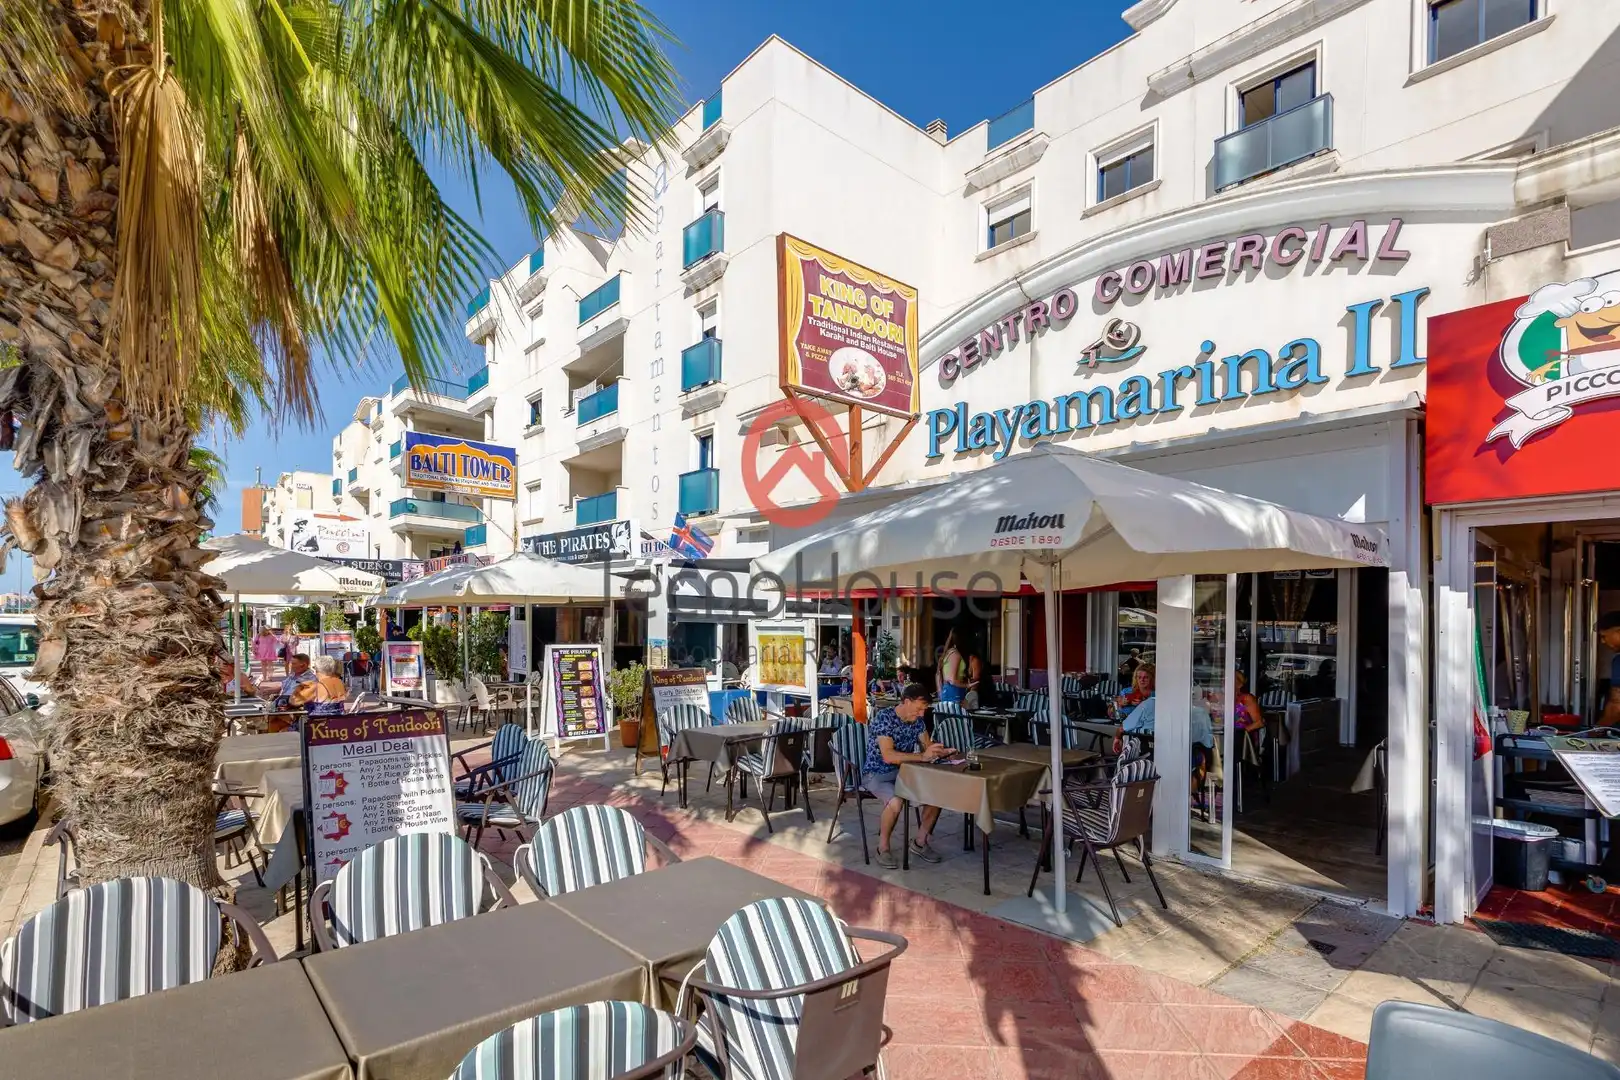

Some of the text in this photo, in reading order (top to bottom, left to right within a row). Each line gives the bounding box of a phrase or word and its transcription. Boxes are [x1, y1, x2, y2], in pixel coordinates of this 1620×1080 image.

[819, 273, 894, 319] KING OF
[938, 217, 1412, 382] CENTRO COMERCIAL
[808, 293, 905, 346] TANDOORI
[807, 316, 906, 354] Traditional Indian Restaurant
[819, 328, 898, 359] Karahi and Balti House
[925, 286, 1431, 461] Playamarina II
[411, 451, 511, 483] BALTI TOWER
[411, 471, 440, 481] TRADITIONAL
[994, 511, 1066, 533] Mahou
[317, 525, 365, 537] Puccini
[535, 531, 611, 556] THE PIRATES
[990, 535, 1061, 547] DESDE 1890
[338, 577, 373, 587] Mahou
[652, 673, 704, 685] King of Tandoori
[310, 715, 442, 741] King of Tandoori
[342, 739, 414, 756] Meal Deal
[417, 751, 443, 760] Pickles
[360, 766, 374, 775] Any
[384, 763, 402, 771] Main
[404, 761, 430, 769] Course
[360, 774, 375, 783] Any
[384, 771, 401, 779] Rice
[419, 766, 438, 775] Naan
[367, 780, 390, 788] Bottle
[401, 776, 424, 784] House
[427, 773, 445, 781] Wine
[404, 790, 419, 798] with
[420, 787, 446, 796] Pickles
[323, 799, 357, 810] persons:
[362, 804, 377, 812] Any
[386, 799, 416, 808] Starters
[363, 811, 377, 820] Any
[387, 808, 405, 816] Main
[407, 804, 433, 812] Course
[363, 819, 378, 827] Any
[387, 816, 404, 824] Rice
[422, 810, 442, 818] Naan
[371, 825, 394, 834] Bottle
[405, 820, 428, 828] House
[430, 816, 448, 825] Wine
[326, 846, 360, 858] persons:
